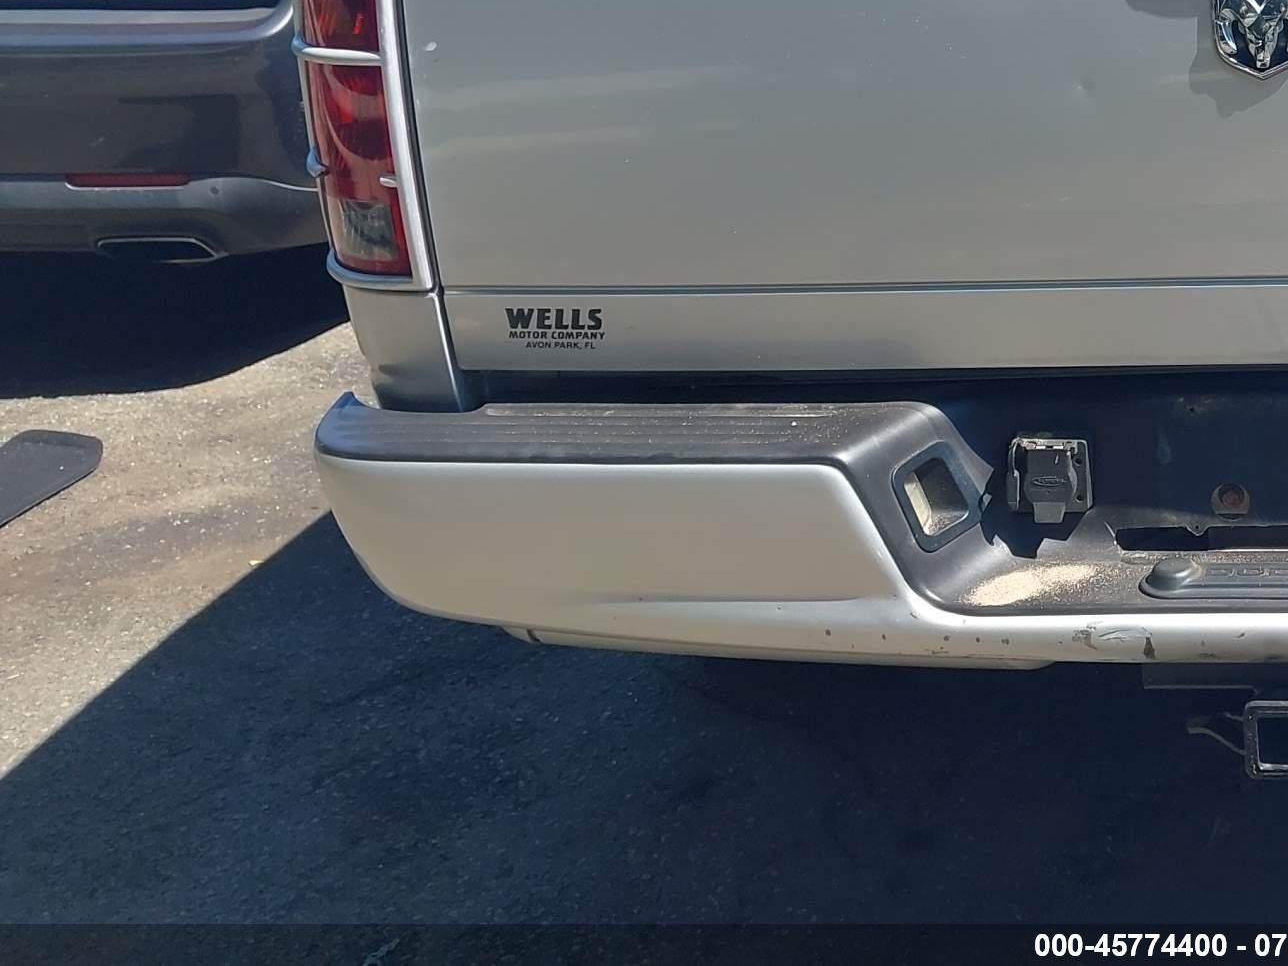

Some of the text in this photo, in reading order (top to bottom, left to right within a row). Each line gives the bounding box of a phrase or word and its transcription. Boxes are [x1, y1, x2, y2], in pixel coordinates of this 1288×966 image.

[505, 308, 603, 331] WELLS
[509, 331, 606, 340] MOTOR COMPANY
[525, 341, 551, 349] AVON
